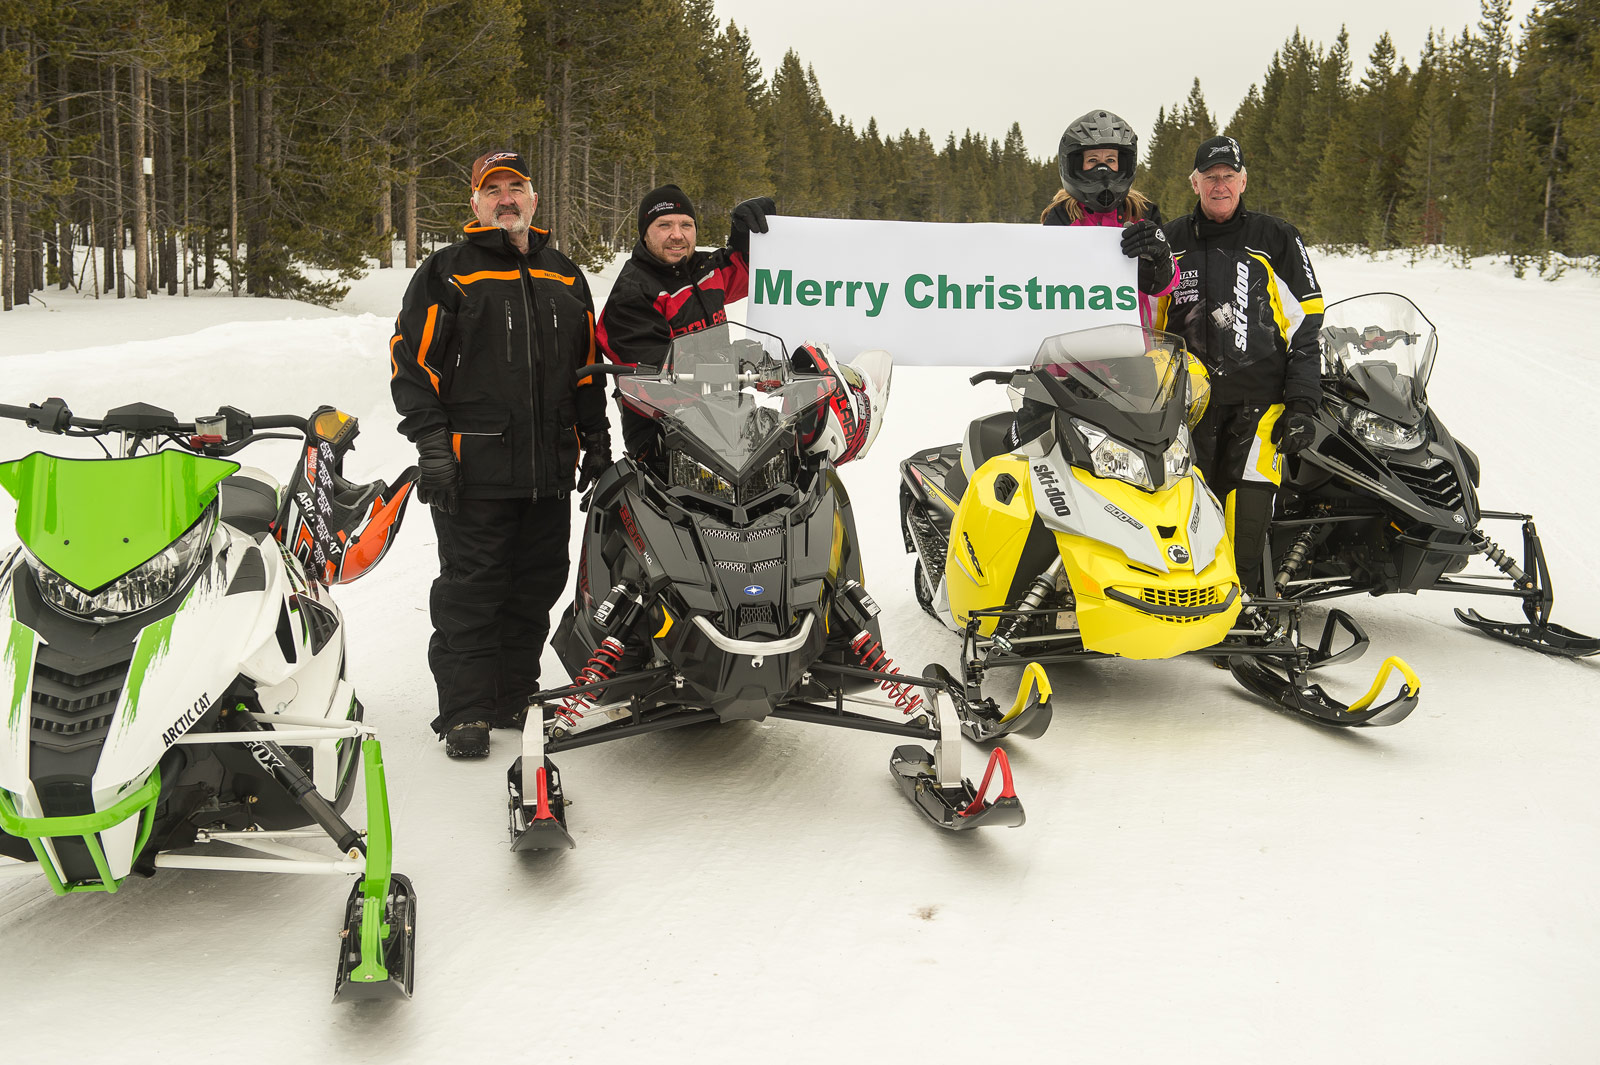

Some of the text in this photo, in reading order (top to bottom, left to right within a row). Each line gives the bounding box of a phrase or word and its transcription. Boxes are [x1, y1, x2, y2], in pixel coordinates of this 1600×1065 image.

[754, 268, 1138, 318] Merry Christmas
[1180, 270, 1198, 280] TAX
[1233, 261, 1249, 352] ski-doo
[1033, 464, 1071, 517] ski-doo
[1104, 503, 1130, 523] 900
[161, 692, 212, 748] ARCTIC CAT
